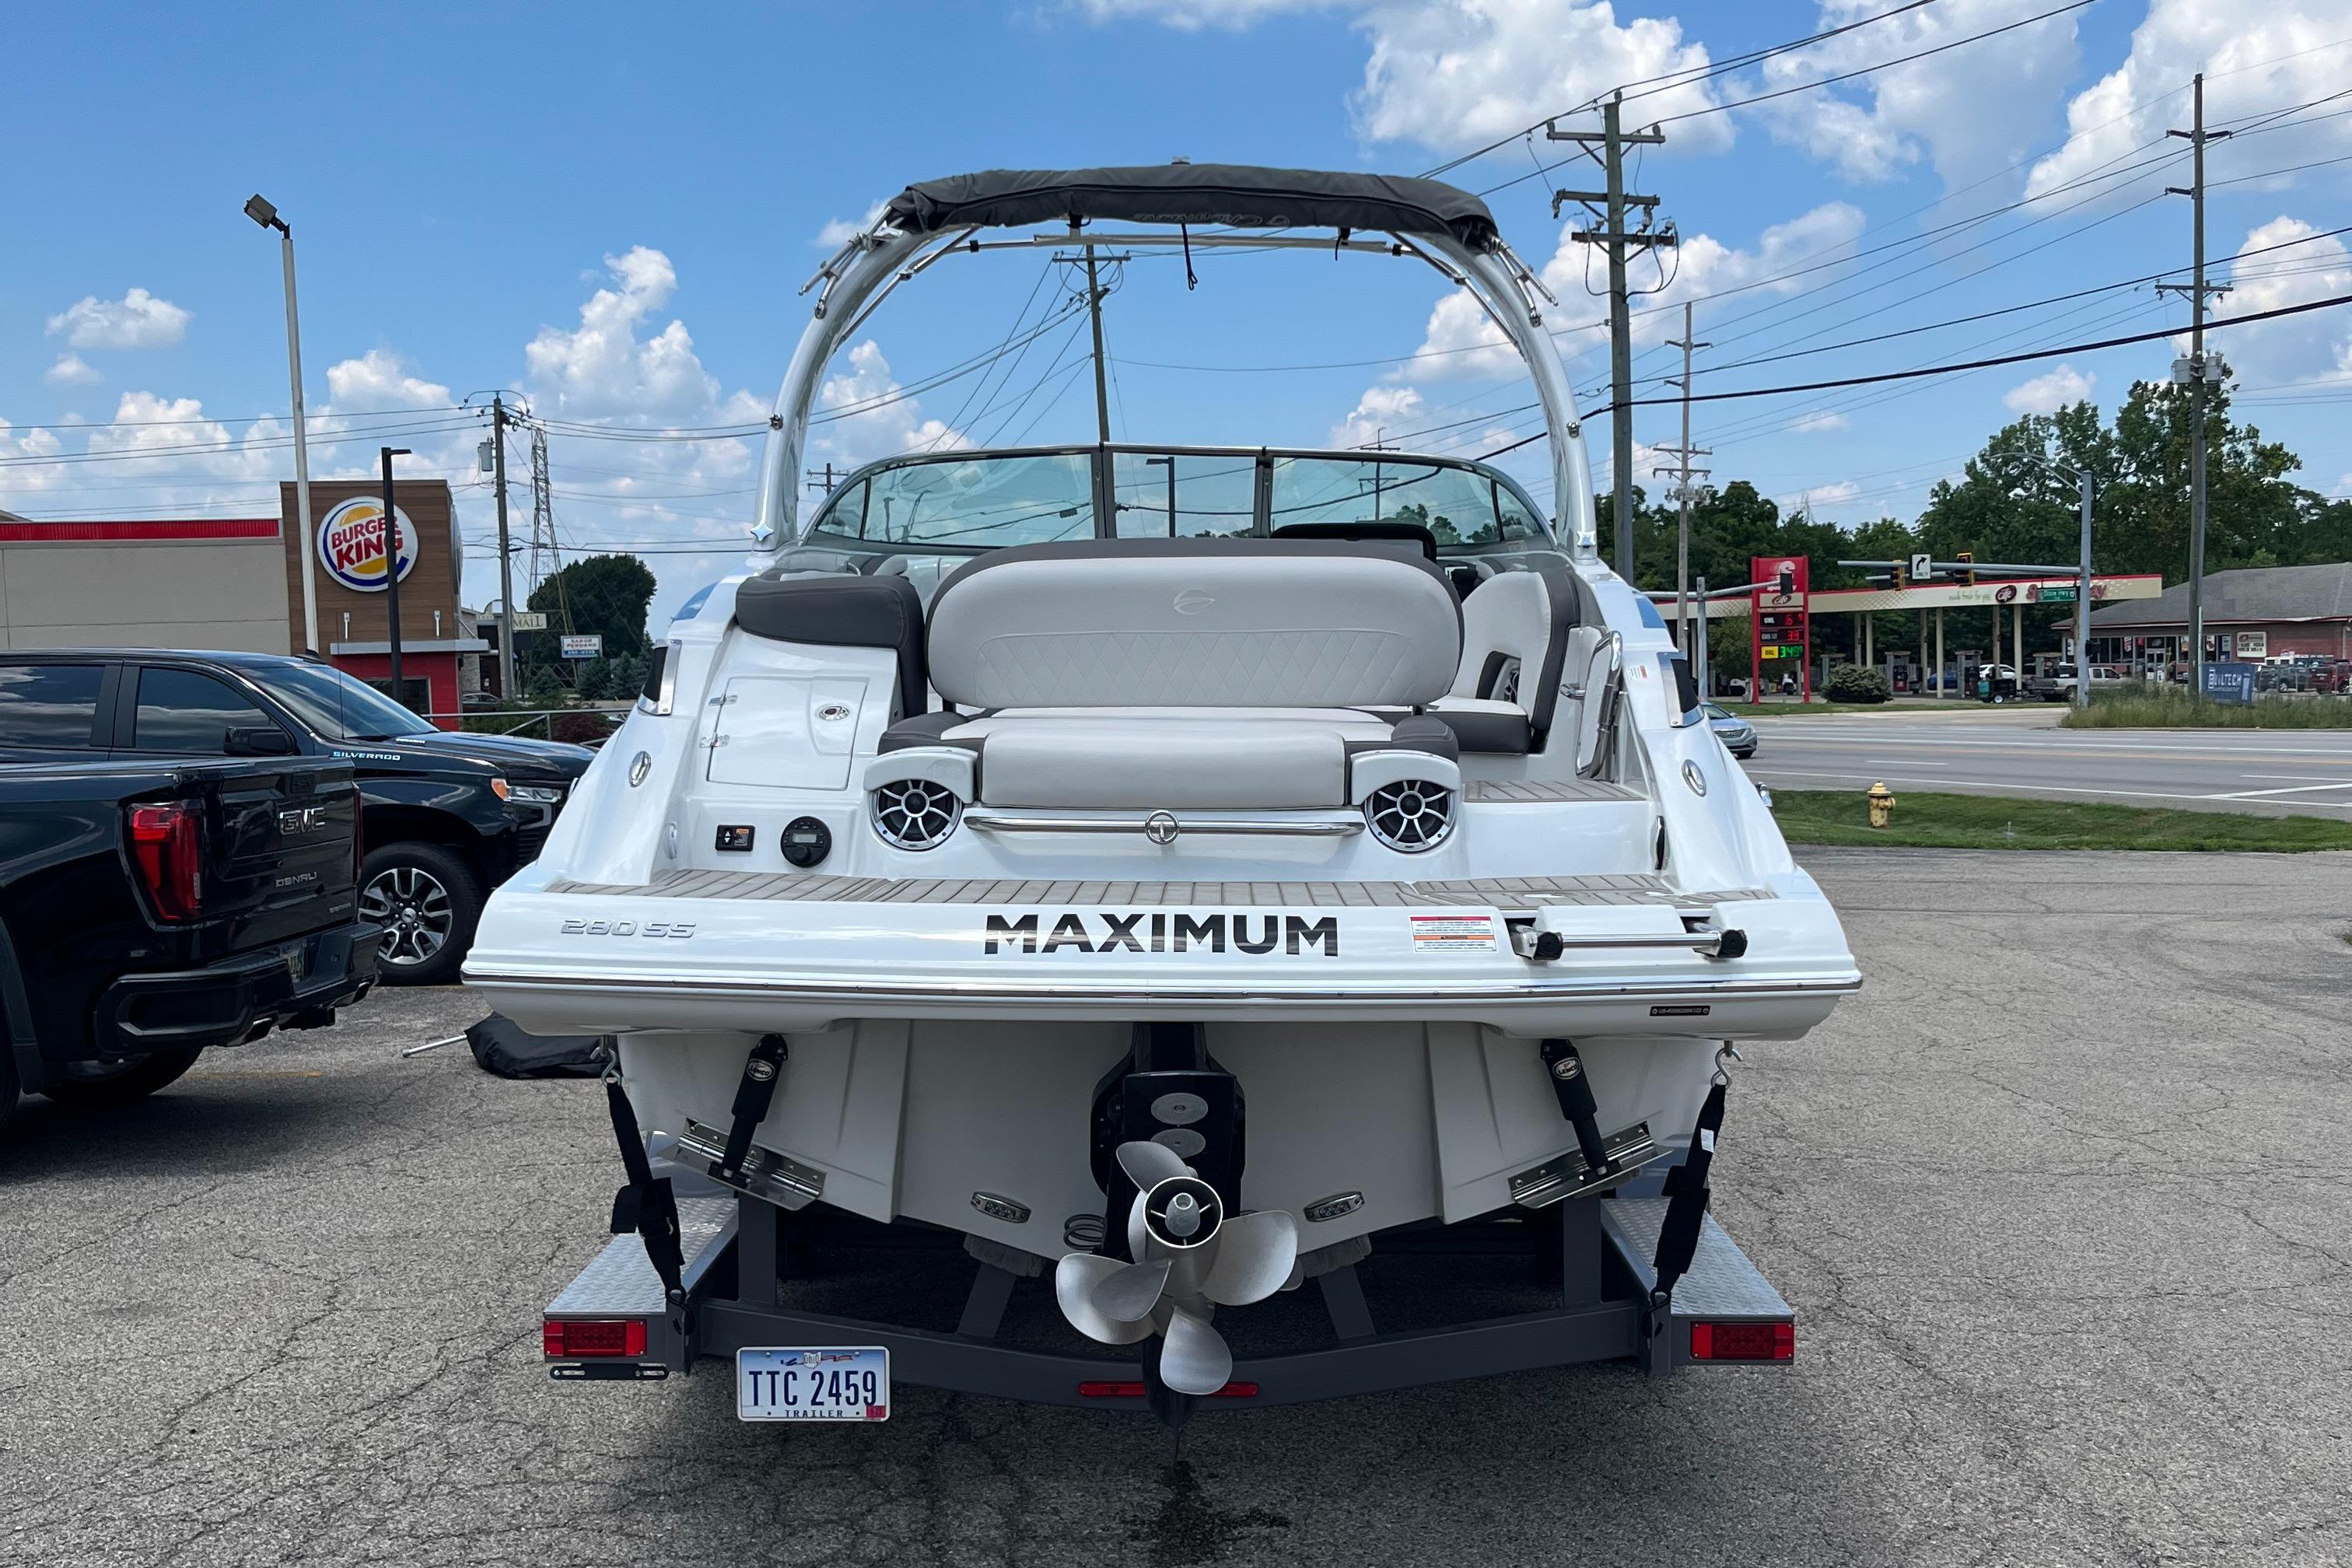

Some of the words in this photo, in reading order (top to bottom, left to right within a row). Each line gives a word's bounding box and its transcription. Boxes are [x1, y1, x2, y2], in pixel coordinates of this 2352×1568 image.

[513, 616, 544, 628] MALL
[333, 751, 401, 761] SILVERADO
[279, 807, 325, 835] GMC
[275, 871, 317, 887] DENALI
[561, 918, 637, 936] 280
[642, 921, 696, 938] SS
[984, 913, 1339, 957] MAXIMUM
[748, 1370, 798, 1406] TTC
[810, 1370, 877, 1406] 2459
[785, 1409, 843, 1418] TRAILER
